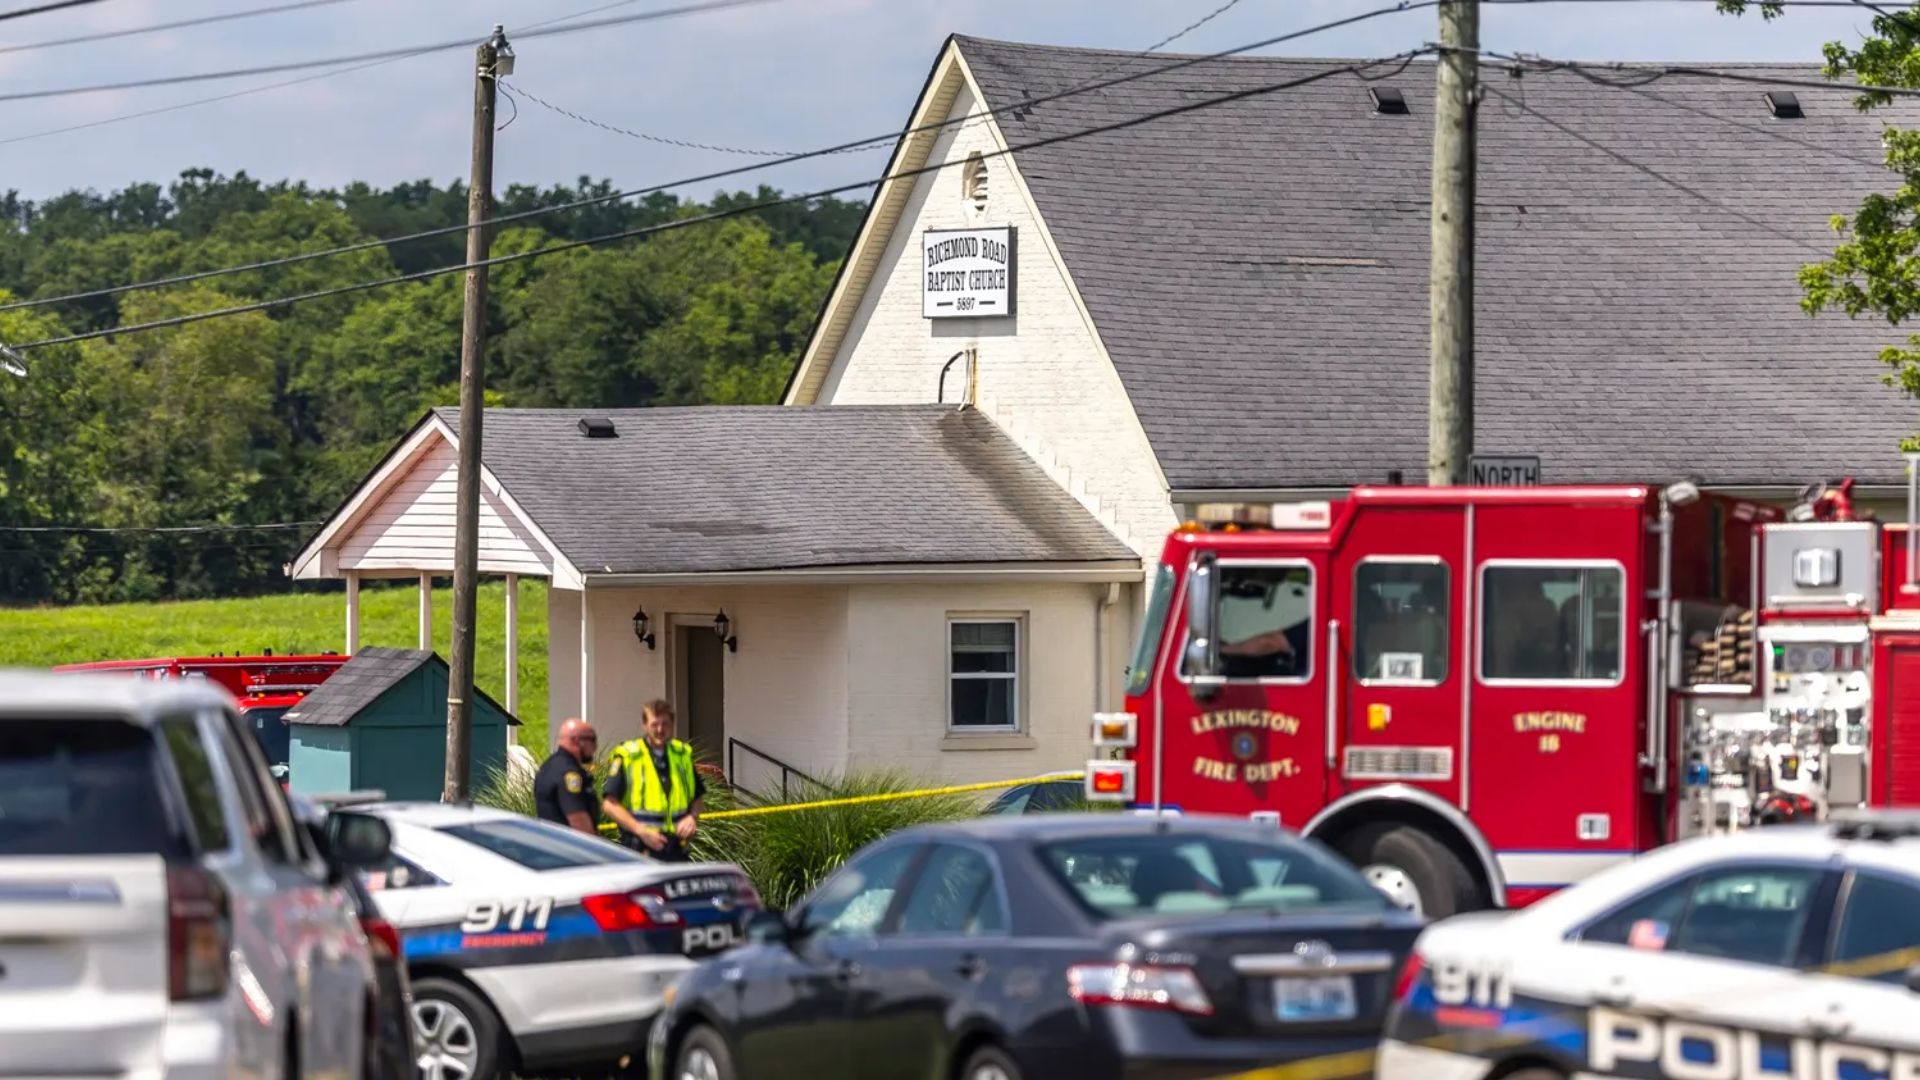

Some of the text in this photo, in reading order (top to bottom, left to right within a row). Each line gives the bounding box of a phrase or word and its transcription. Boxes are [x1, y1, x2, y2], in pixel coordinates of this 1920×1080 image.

[927, 236, 1007, 268] RICHMOND ROAD
[927, 268, 1006, 292] BAPTIST CHURCH
[1473, 464, 1537, 487] NORTH
[1190, 709, 1300, 736] LEXINGTON
[1512, 710, 1588, 734] ENGINE
[1192, 756, 1302, 784] FIRE DEPT.
[460, 898, 554, 933] 911
[1432, 956, 1511, 1009] 911
[1587, 1005, 1920, 1080] POLIC
